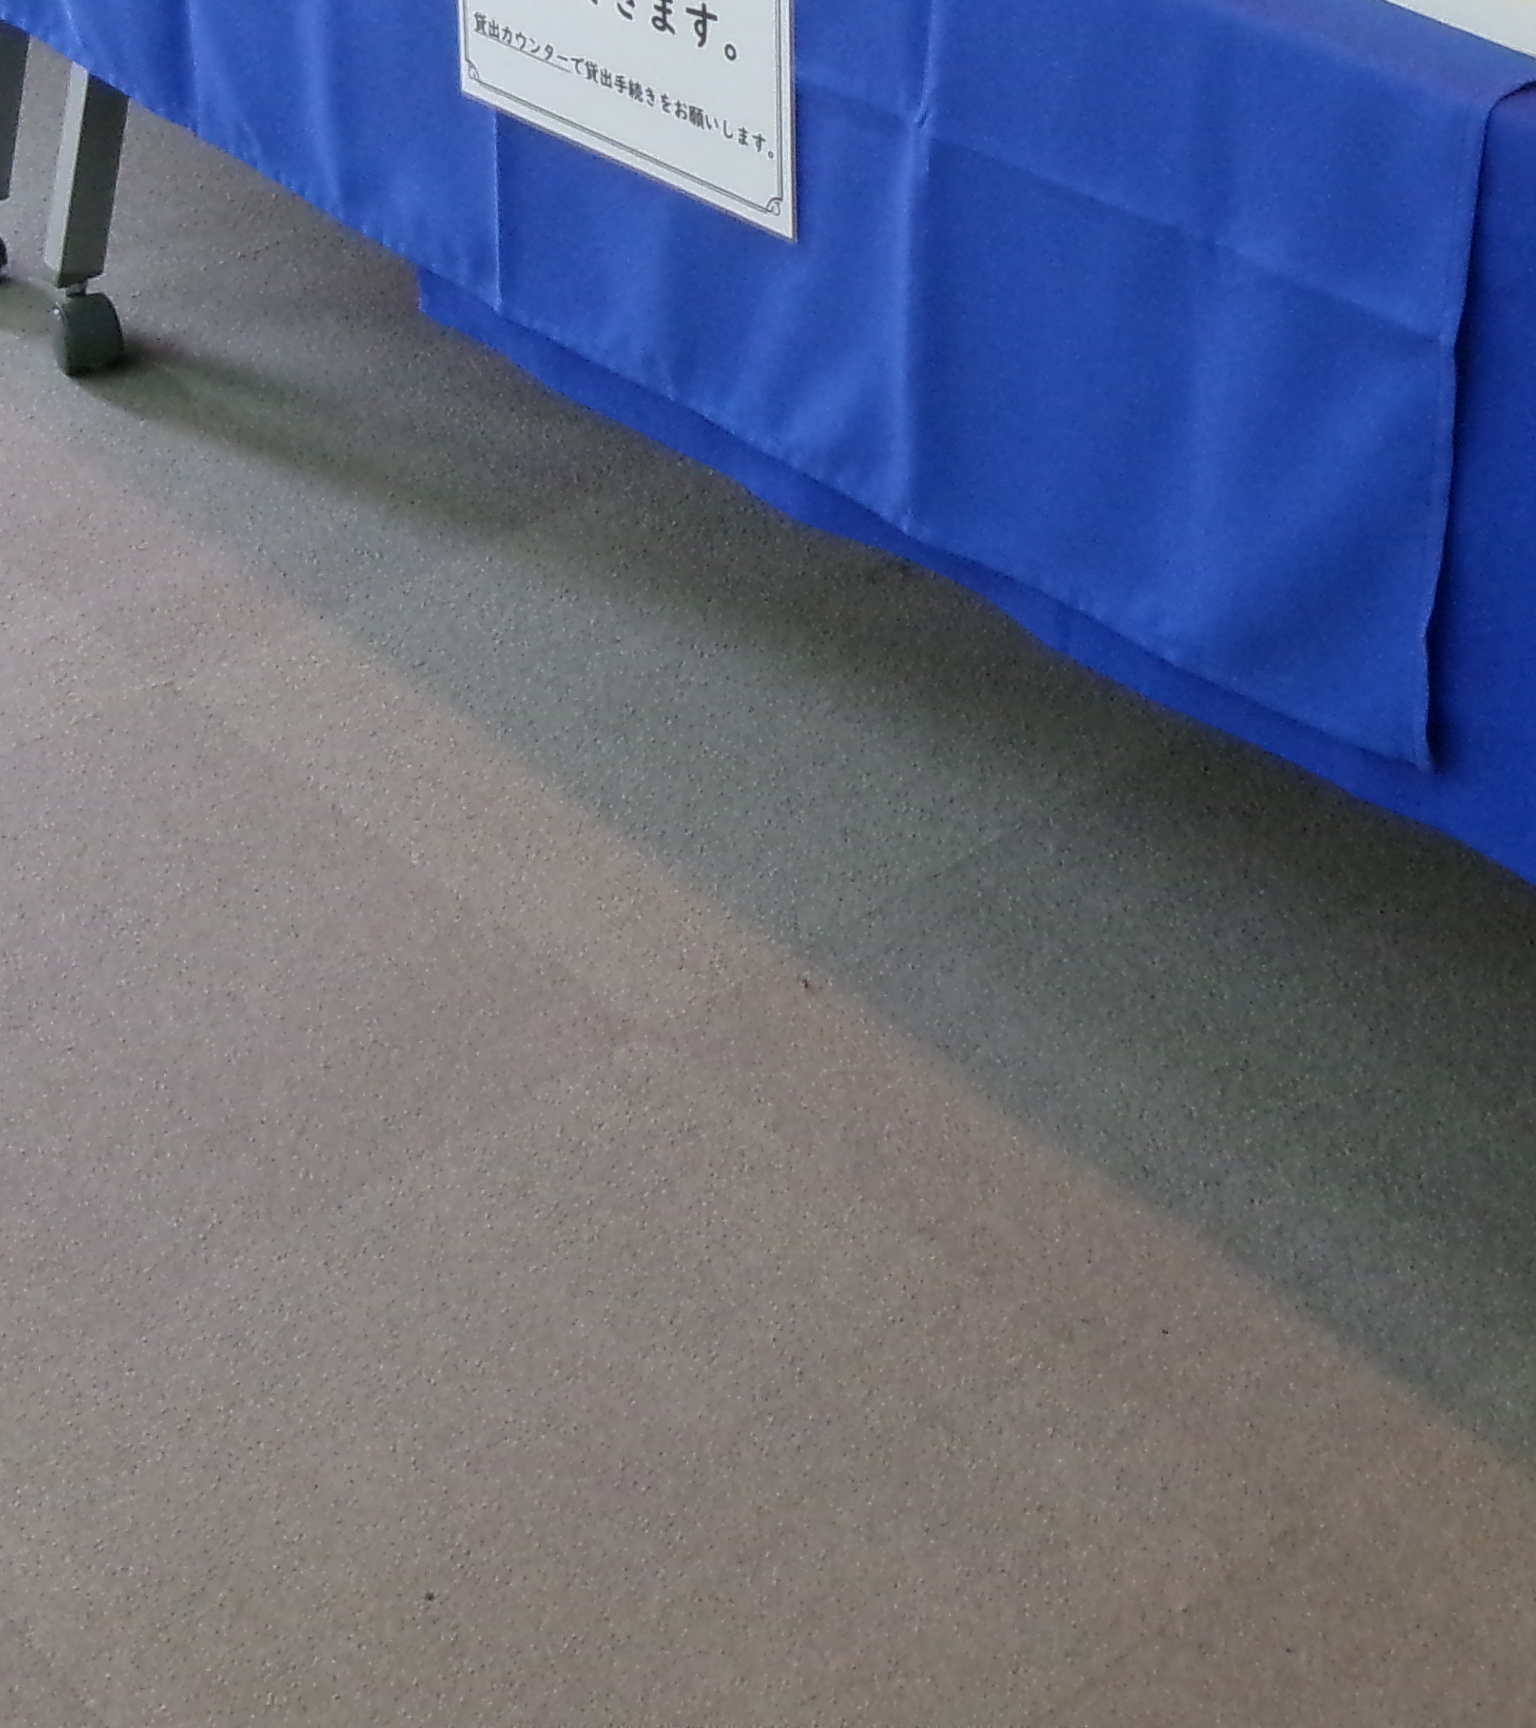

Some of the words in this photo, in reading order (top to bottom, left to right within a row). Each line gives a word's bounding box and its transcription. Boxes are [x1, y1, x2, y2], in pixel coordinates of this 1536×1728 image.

[473, 11, 775, 161] 貸出カウンターで貸出手続きをお願いします。
